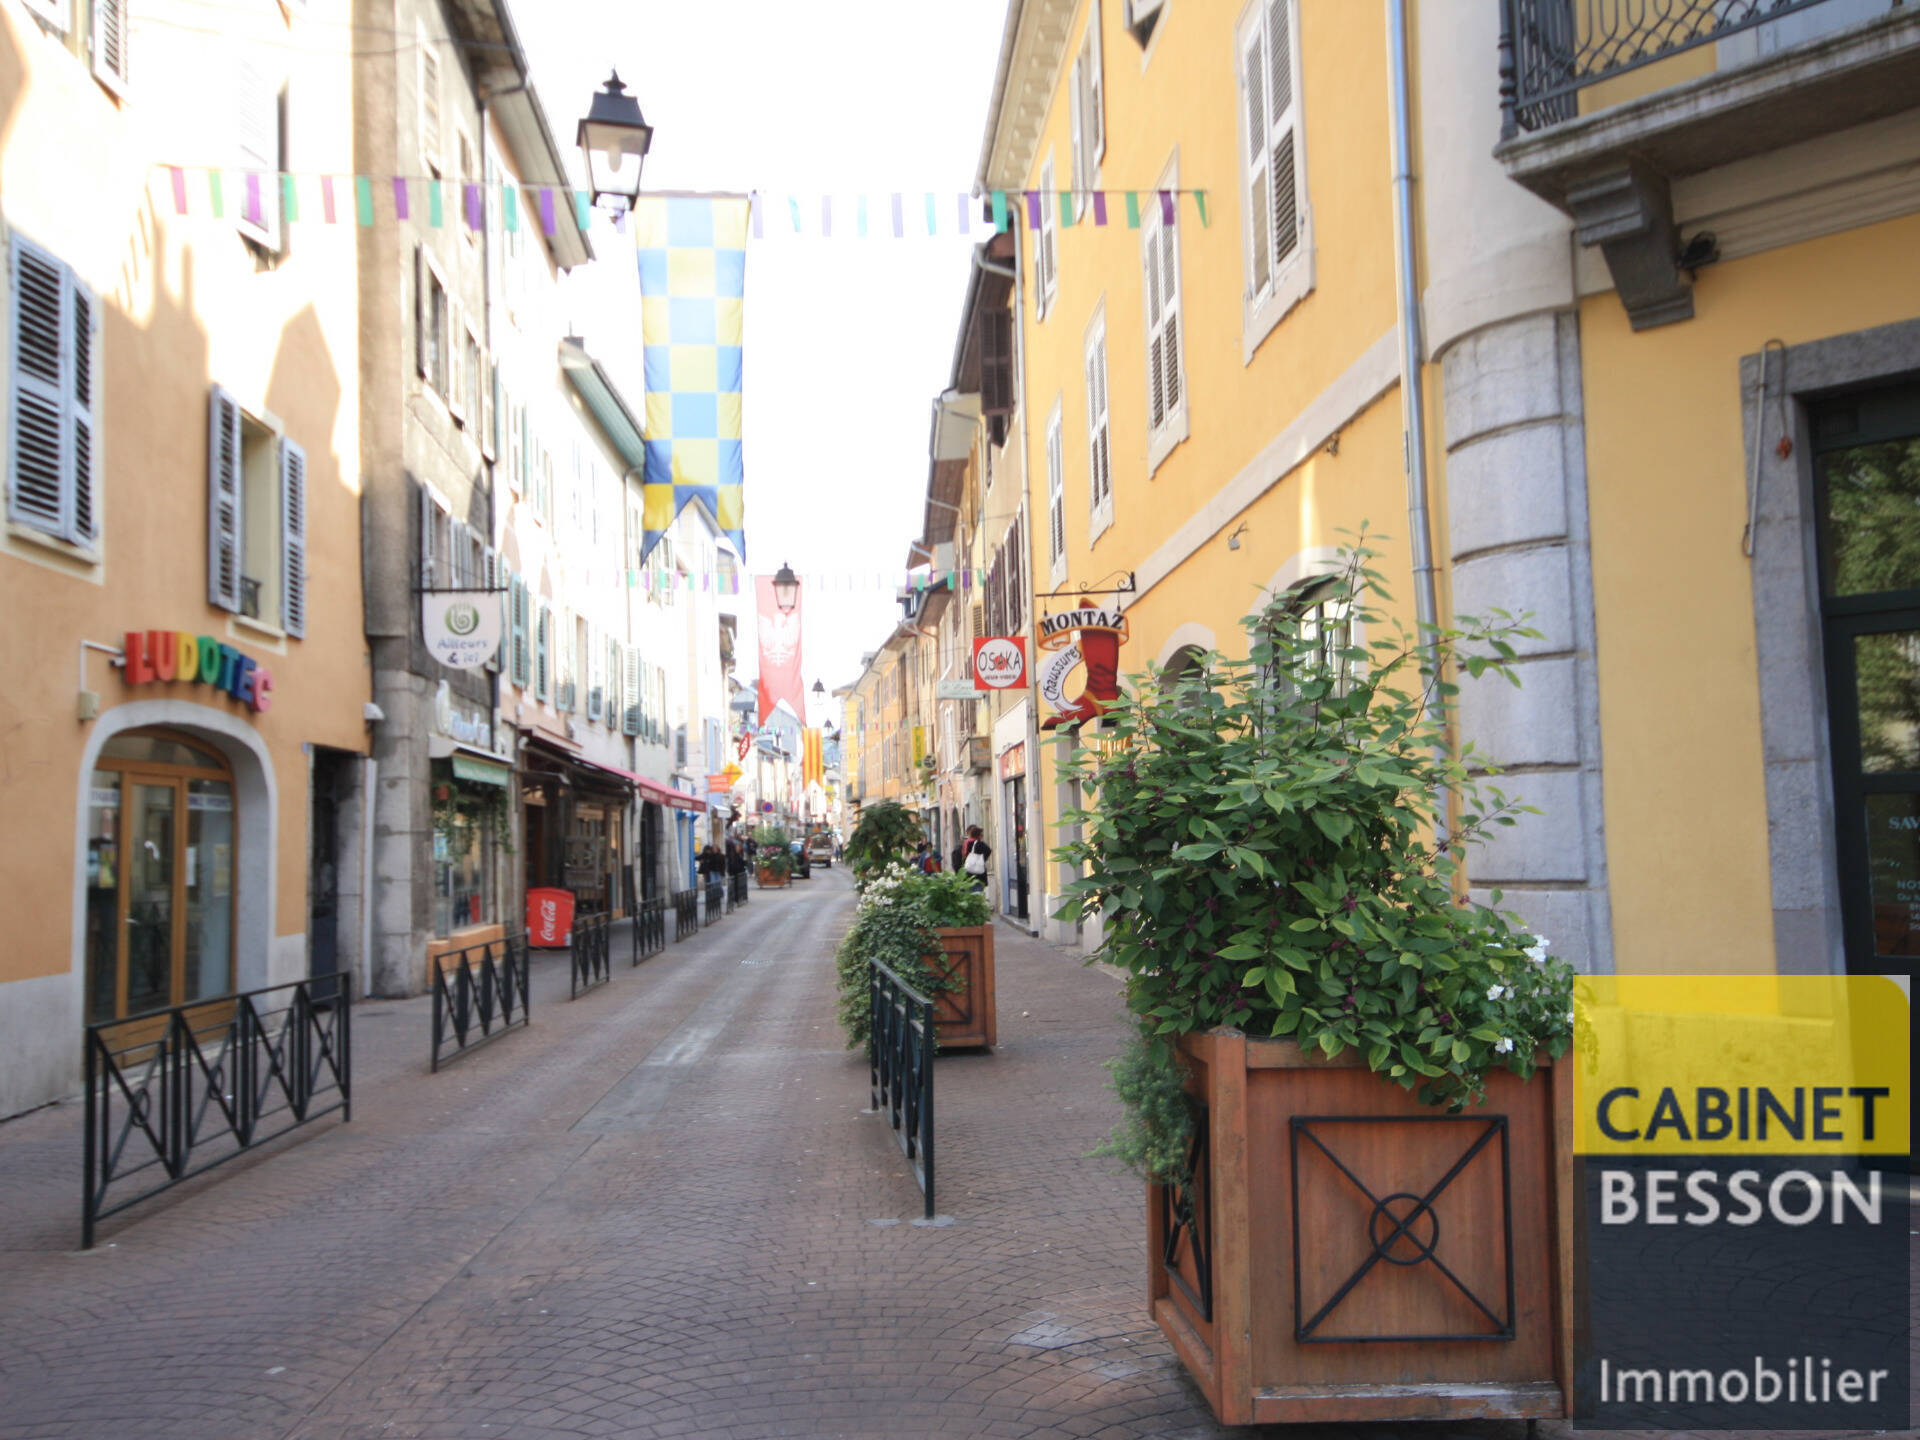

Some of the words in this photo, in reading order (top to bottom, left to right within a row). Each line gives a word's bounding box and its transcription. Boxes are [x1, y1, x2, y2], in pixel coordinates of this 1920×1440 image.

[1041, 610, 1125, 637] MONTAZ
[125, 630, 273, 712] LUDOTEC
[978, 650, 1021, 671] OSAKA
[1043, 645, 1082, 701] Chaussures
